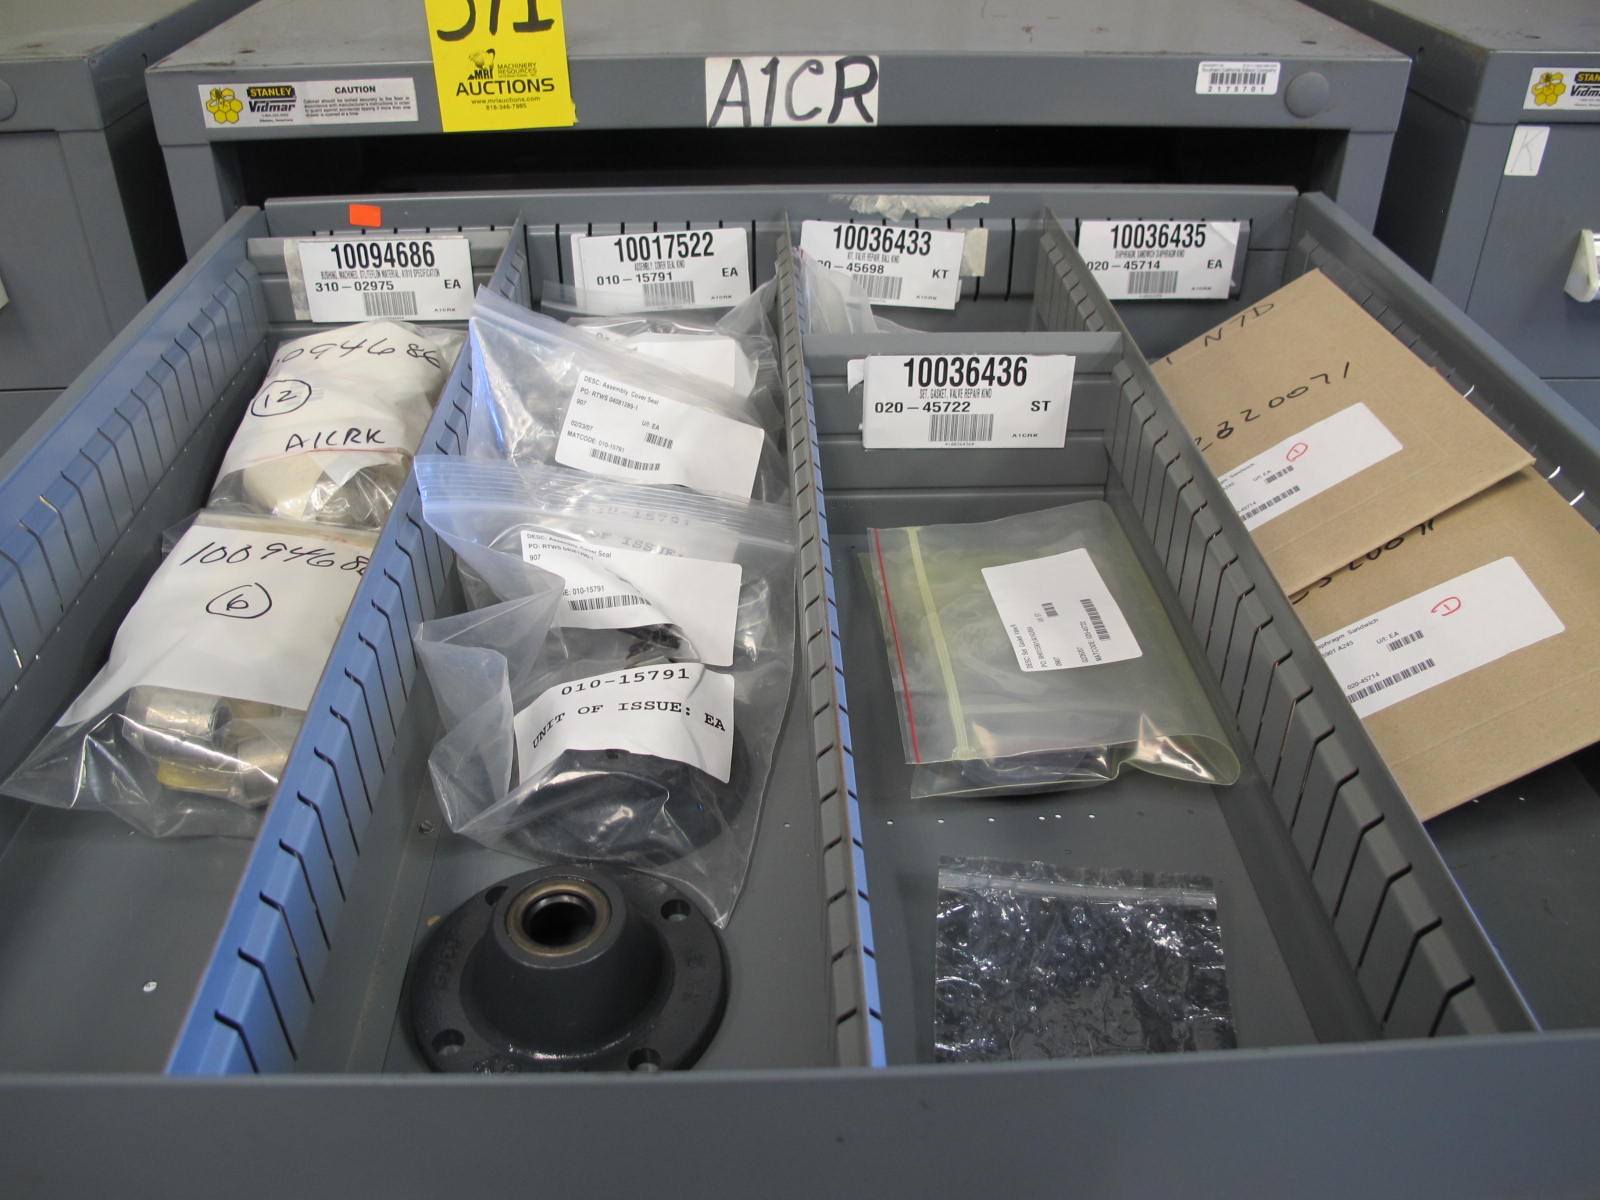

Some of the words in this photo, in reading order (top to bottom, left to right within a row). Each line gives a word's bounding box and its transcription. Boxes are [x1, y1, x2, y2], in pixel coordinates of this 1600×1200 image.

[473, 68, 494, 80] MRI
[250, 87, 292, 97] STANLEY
[334, 85, 377, 94] CAUTION
[456, 78, 555, 96] AUCTIONS
[707, 55, 879, 127] A1CR
[249, 100, 296, 113] Vidmar
[833, 225, 932, 256] 10036433
[1111, 223, 1207, 249] 10036435
[331, 241, 436, 269] 10094686
[614, 231, 714, 262] 10017522
[722, 267, 739, 277] EA
[1207, 259, 1223, 269] EA
[932, 269, 950, 279] KT
[444, 279, 462, 289] EA
[904, 356, 1028, 387] 10036436
[265, 390, 297, 409] 12
[602, 382, 628, 397] Assembly
[631, 391, 647, 401] Cover
[1031, 400, 1052, 412] ST
[572, 585, 605, 596] 010-15791
[560, 667, 691, 696] 010-15791
[532, 711, 566, 749] UNIT
[577, 704, 604, 715] OF
[618, 700, 692, 716] ISSUE:
[704, 712, 726, 732] EA
